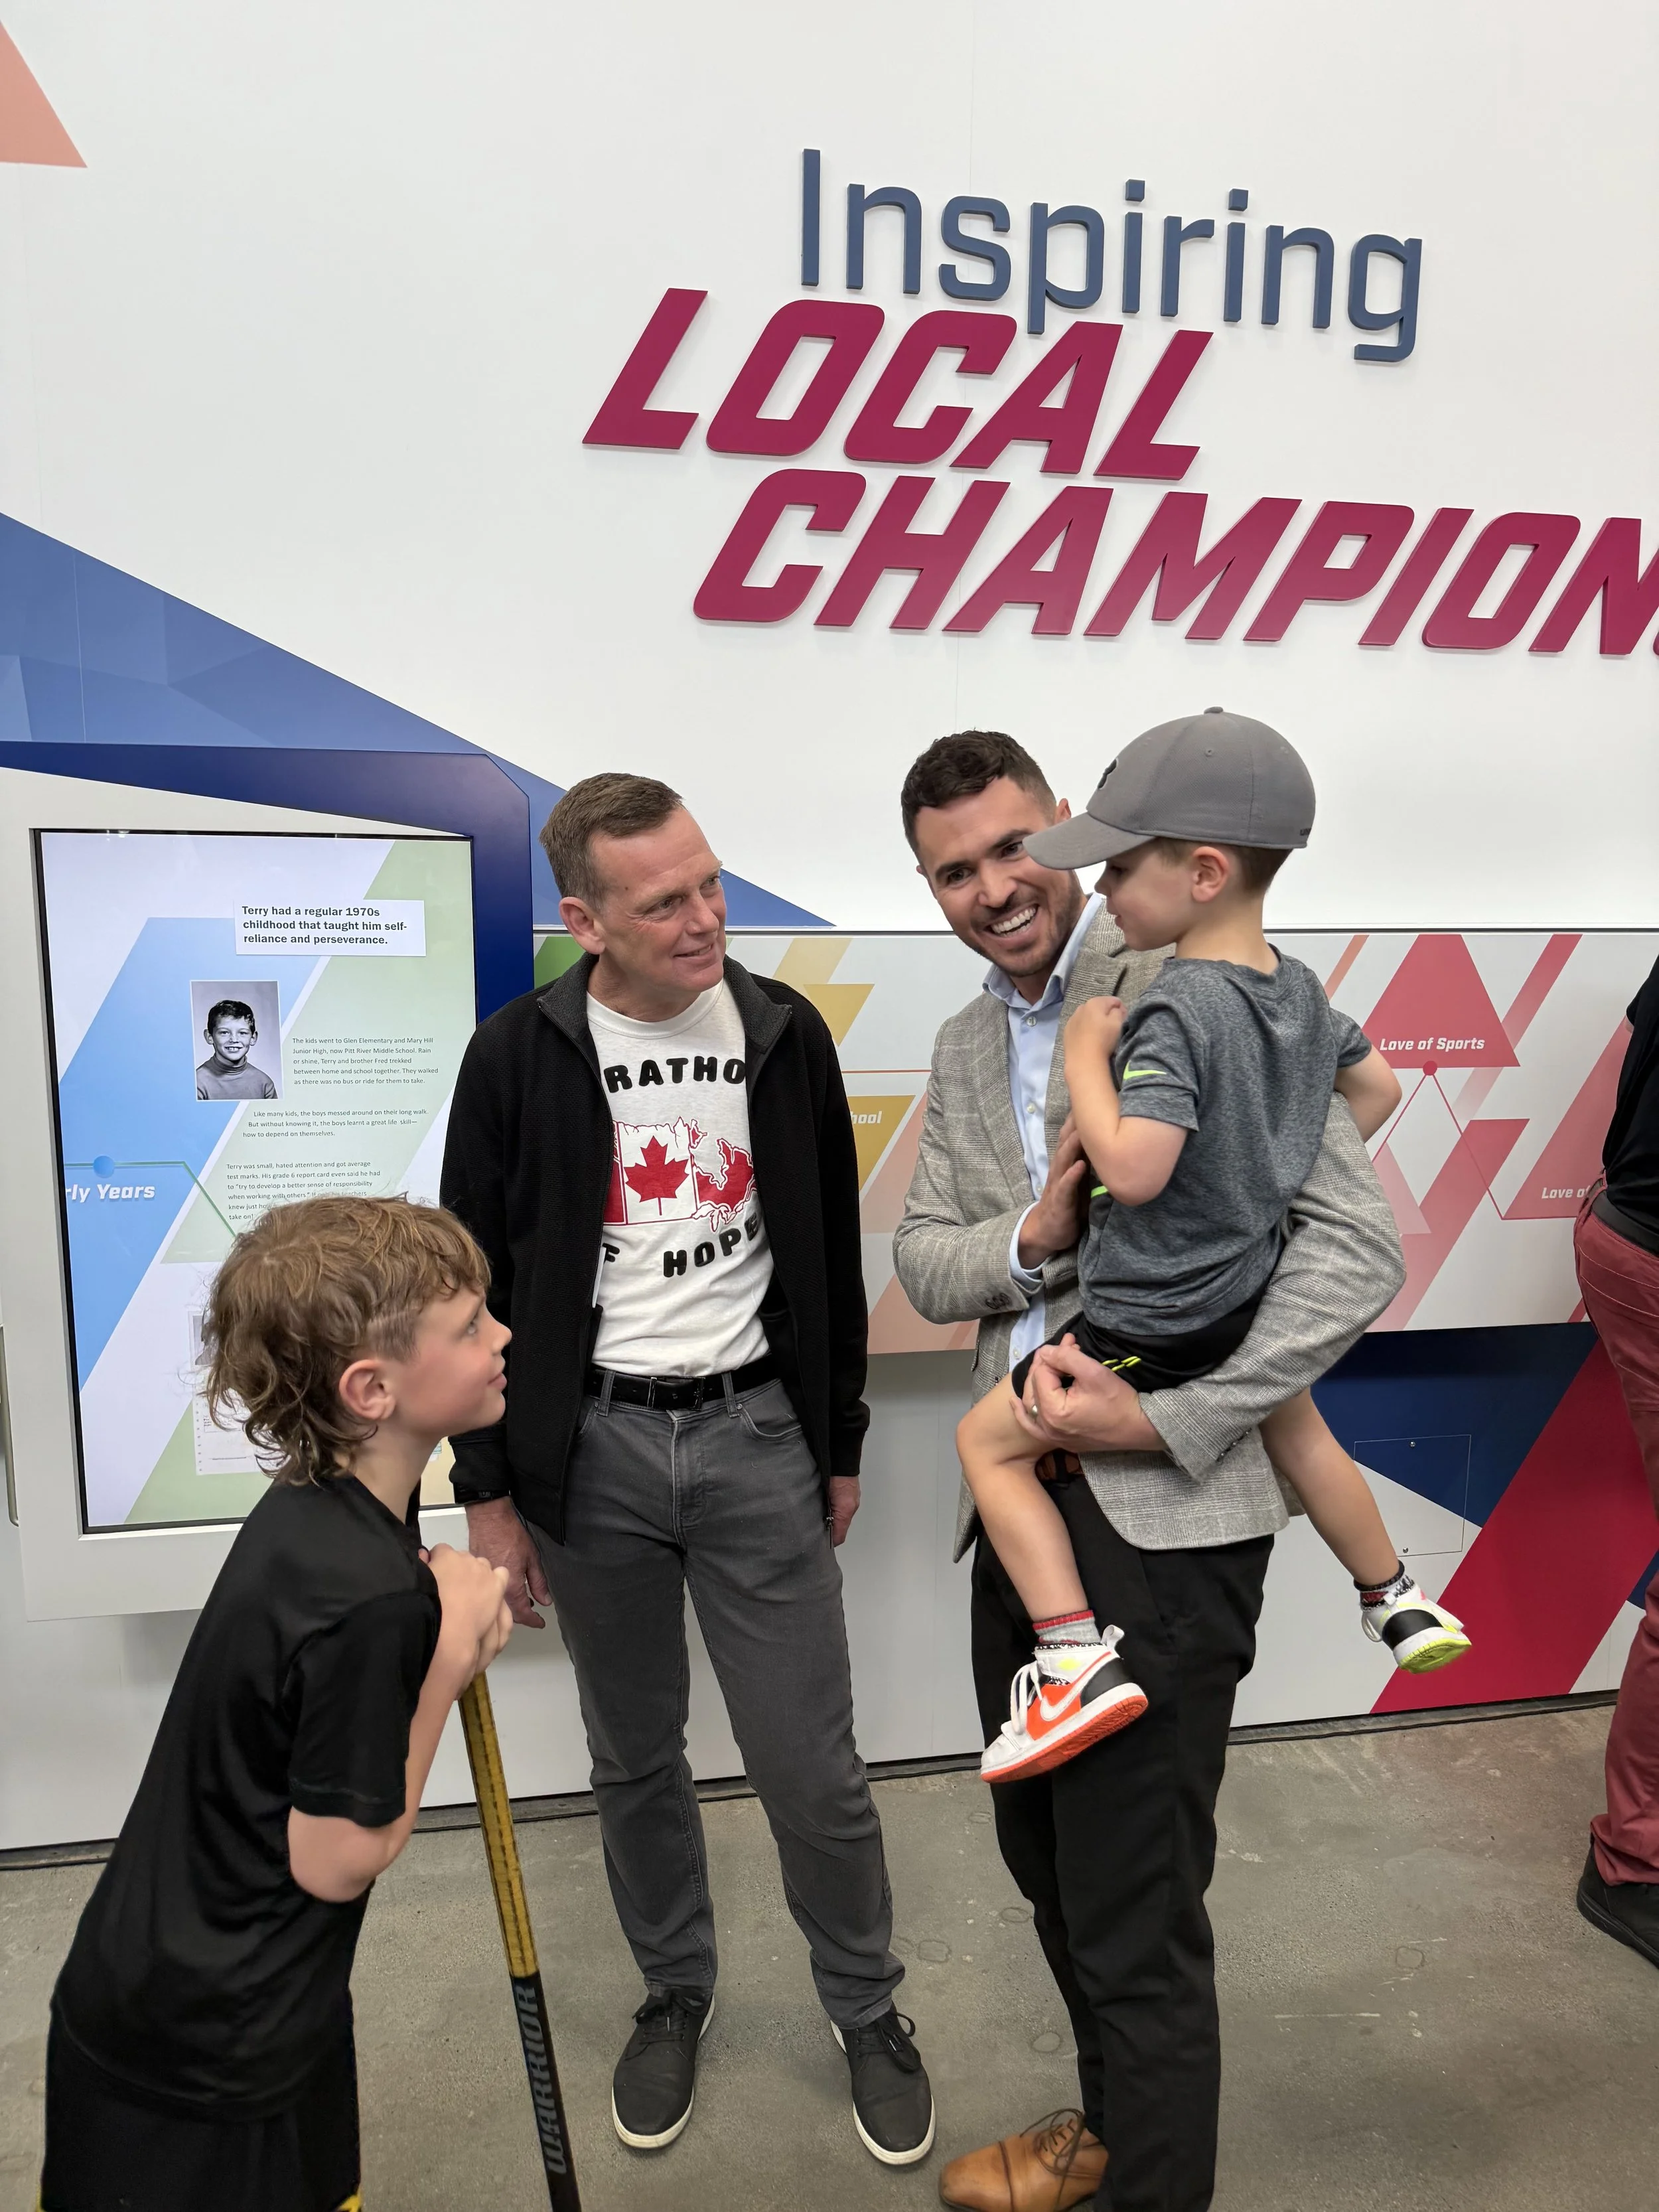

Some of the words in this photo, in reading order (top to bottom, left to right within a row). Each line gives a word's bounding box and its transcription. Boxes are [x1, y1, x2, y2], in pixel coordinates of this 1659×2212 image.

[802, 148, 1421, 362] Inspiring
[582, 288, 1214, 480] LOCAL
[693, 469, 1659, 655] CHAMPION
[242, 906, 268, 917] Terry
[305, 907, 342, 917] regular
[244, 920, 295, 929] childhood
[299, 921, 321, 929] that
[323, 921, 359, 931] taught
[362, 921, 381, 930] him
[385, 922, 407, 930] self-
[291, 934, 310, 943] and
[1380, 1039, 1414, 1051] Love
[1417, 1037, 1434, 1050] of
[1436, 1037, 1485, 1052] Sports
[97, 1183, 155, 1200] Years
[1542, 1187, 1573, 1199] Love
[664, 1212, 759, 1278] HOPE
[515, 1985, 567, 2175] WARRIOR
